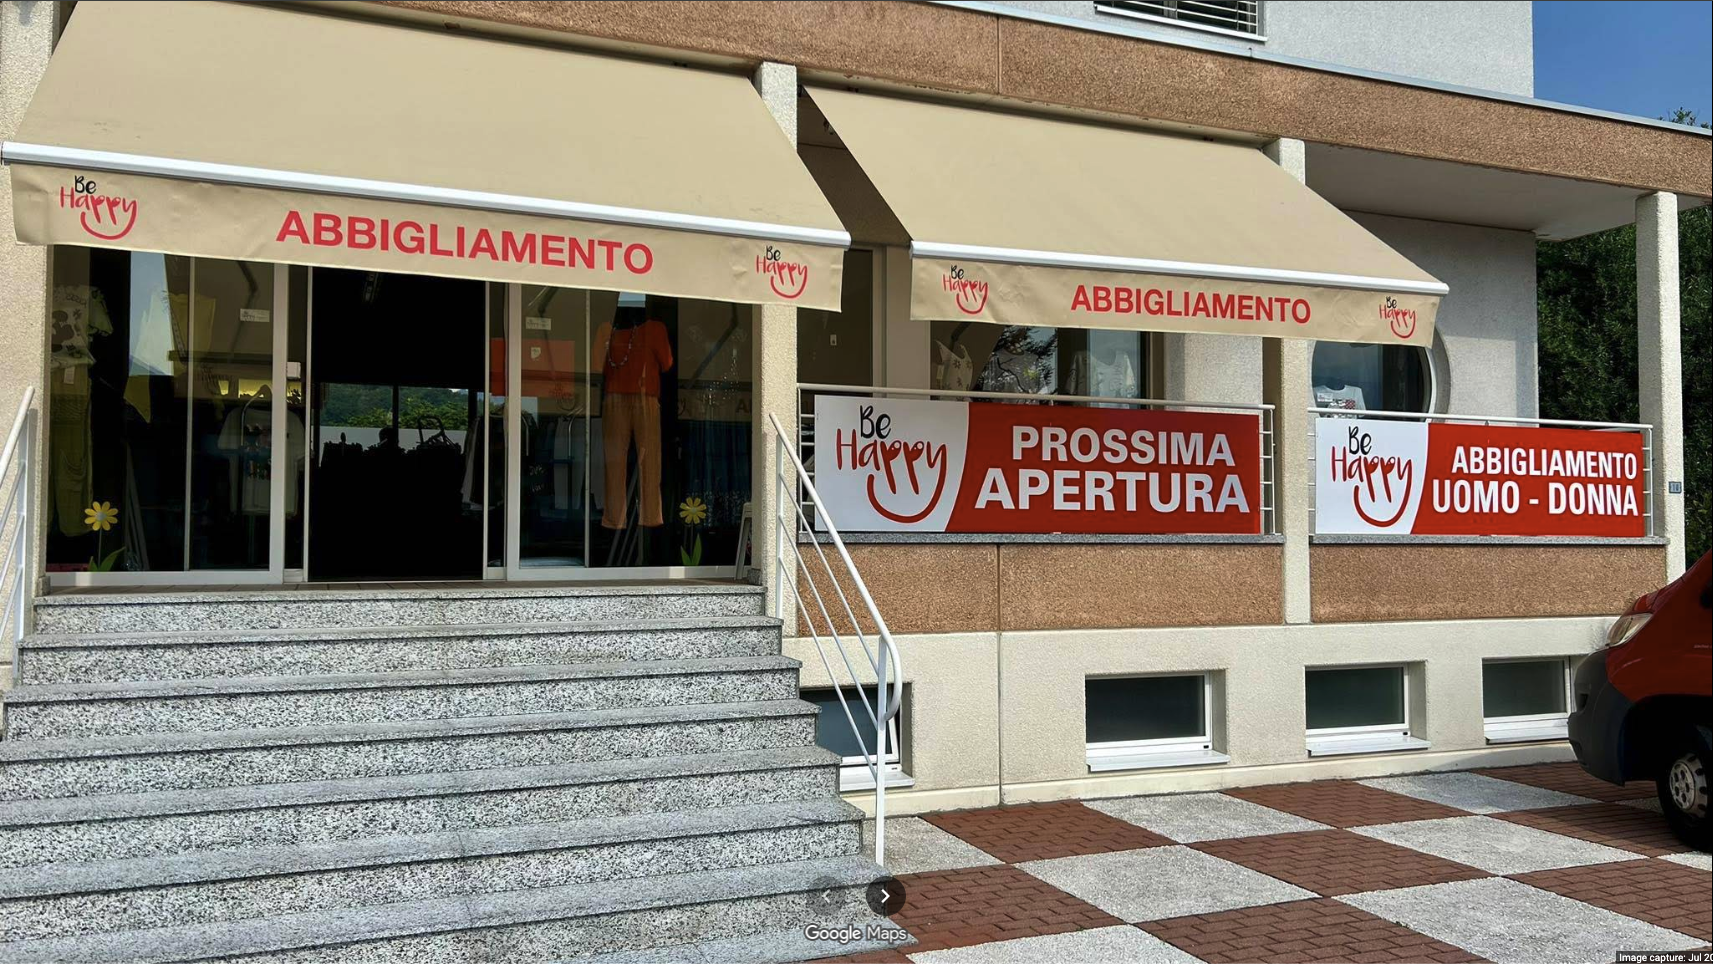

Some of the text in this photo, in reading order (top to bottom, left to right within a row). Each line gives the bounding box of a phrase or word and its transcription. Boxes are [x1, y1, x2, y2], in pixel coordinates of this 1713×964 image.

[74, 175, 97, 195] Be
[60, 186, 138, 241] Happy
[276, 209, 655, 275] ABBIGLIAMENTO
[766, 245, 781, 262] Be
[755, 256, 808, 299] Happy
[950, 265, 965, 280] Be
[942, 273, 989, 315] Happy
[1070, 284, 1311, 325] ABBIGLIAMENTO
[1386, 296, 1397, 309] Be
[1379, 303, 1417, 339] Happy
[859, 405, 891, 440] Be
[1348, 426, 1372, 456] Be
[1012, 425, 1236, 467] PROSSIMA
[1452, 446, 1637, 480] ABBIGLIAMENTO
[836, 428, 947, 524] Happy
[974, 467, 1250, 514] APERTURA
[1331, 446, 1412, 527] Happy
[1433, 480, 1520, 514] UOMO
[1549, 482, 1639, 516] DONNA
